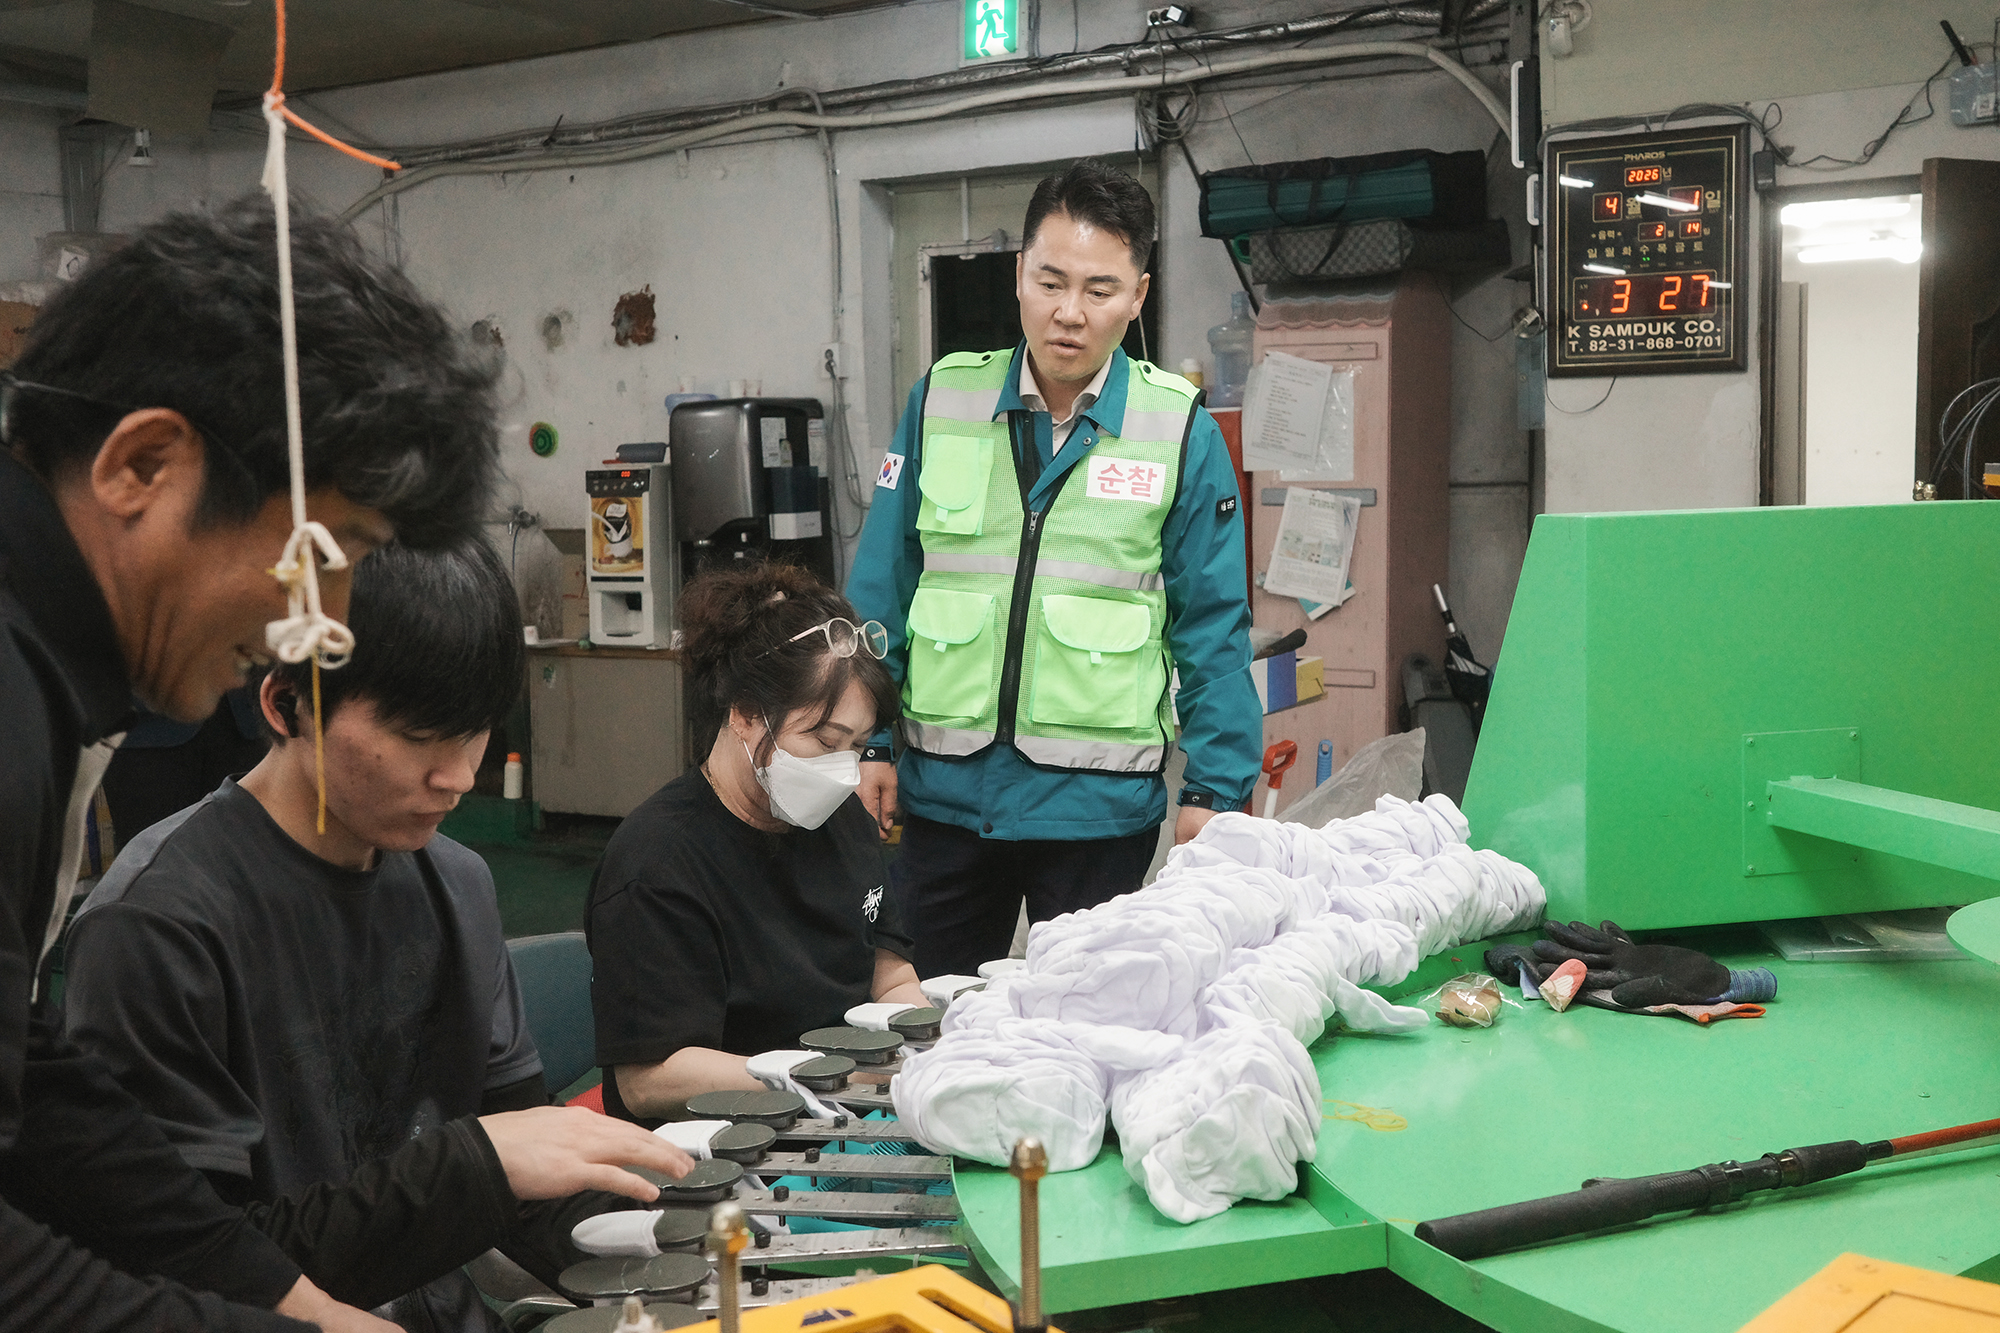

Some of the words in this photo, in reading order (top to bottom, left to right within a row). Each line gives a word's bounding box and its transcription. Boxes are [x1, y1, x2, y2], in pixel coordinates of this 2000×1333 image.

[1624, 151, 1666, 161] PHAROS
[1628, 168, 1659, 183] 2026
[1605, 197, 1619, 215] 4
[1693, 190, 1700, 207] 1
[1705, 190, 1721, 208] 일
[1655, 223, 1665, 237] 2
[1686, 222, 1700, 234] 14
[1639, 245, 1650, 255] 수
[1610, 279, 1632, 314] 3
[1659, 274, 1710, 311] 27
[1568, 326, 1581, 339] K
[1589, 321, 1677, 337] SAMDUK
[1684, 319, 1722, 334] CO.
[1569, 341, 1584, 353] T.
[1589, 335, 1722, 352] 82-31-868-0701
[1097, 463, 1158, 498] 순찰
